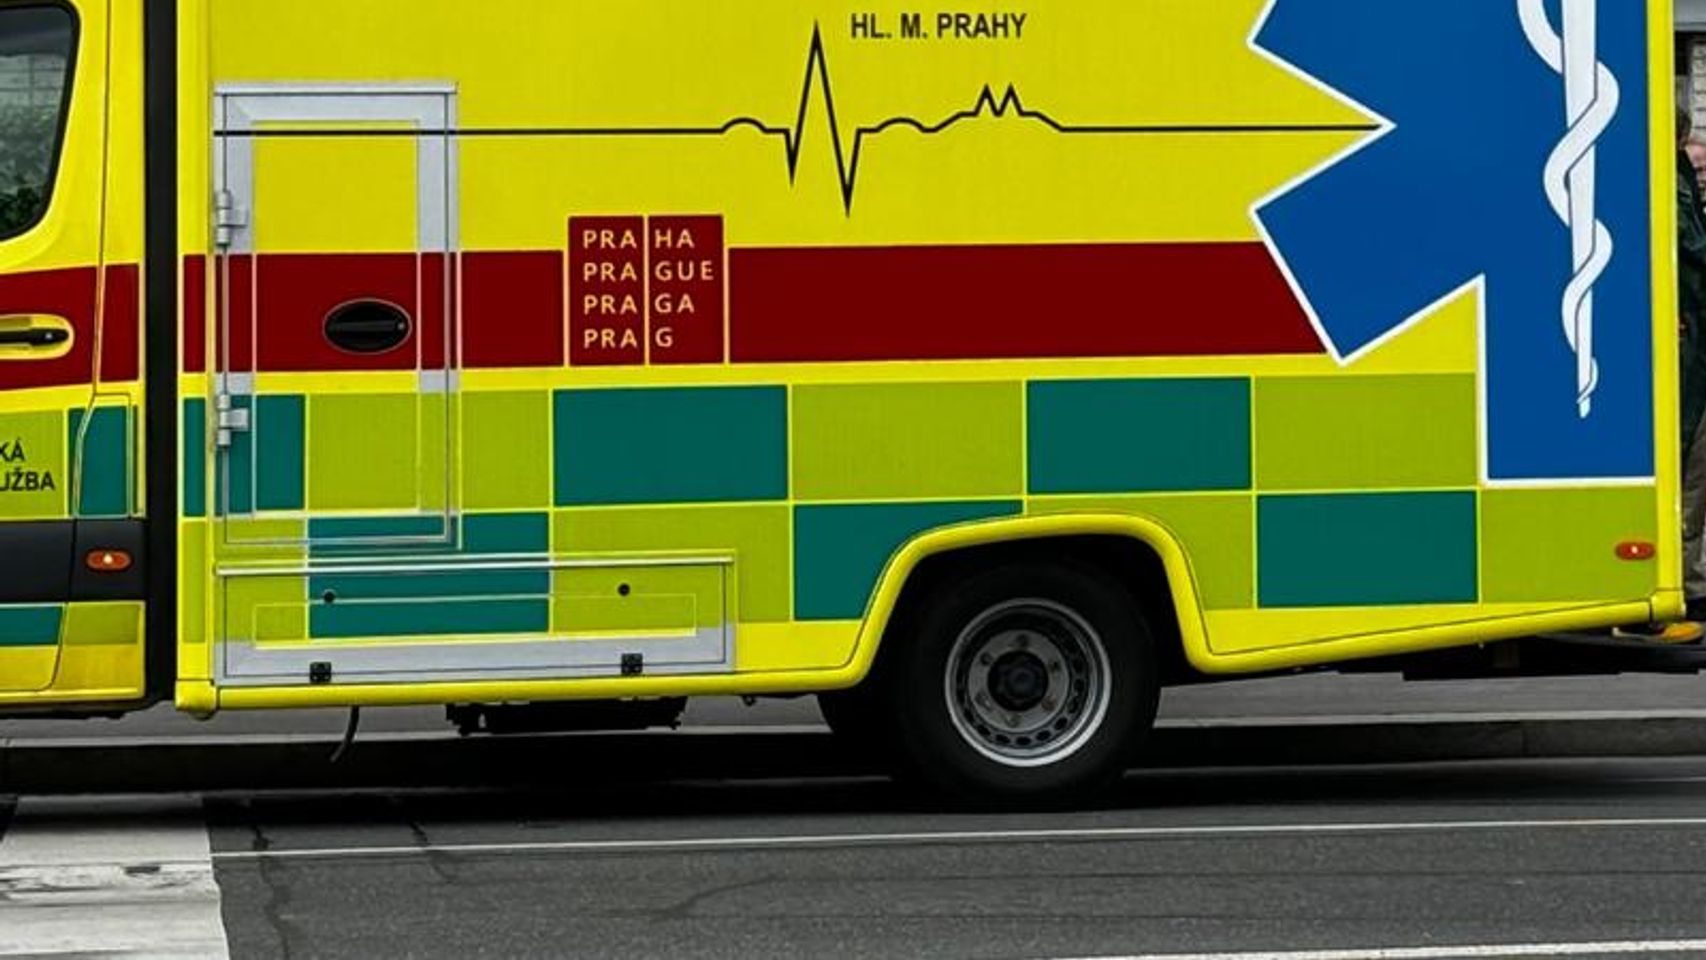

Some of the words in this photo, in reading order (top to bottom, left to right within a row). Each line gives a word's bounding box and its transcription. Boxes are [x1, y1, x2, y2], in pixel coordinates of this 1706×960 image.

[851, 13, 892, 39] HL.
[900, 13, 928, 39] M.
[936, 12, 1027, 39] PRAHY
